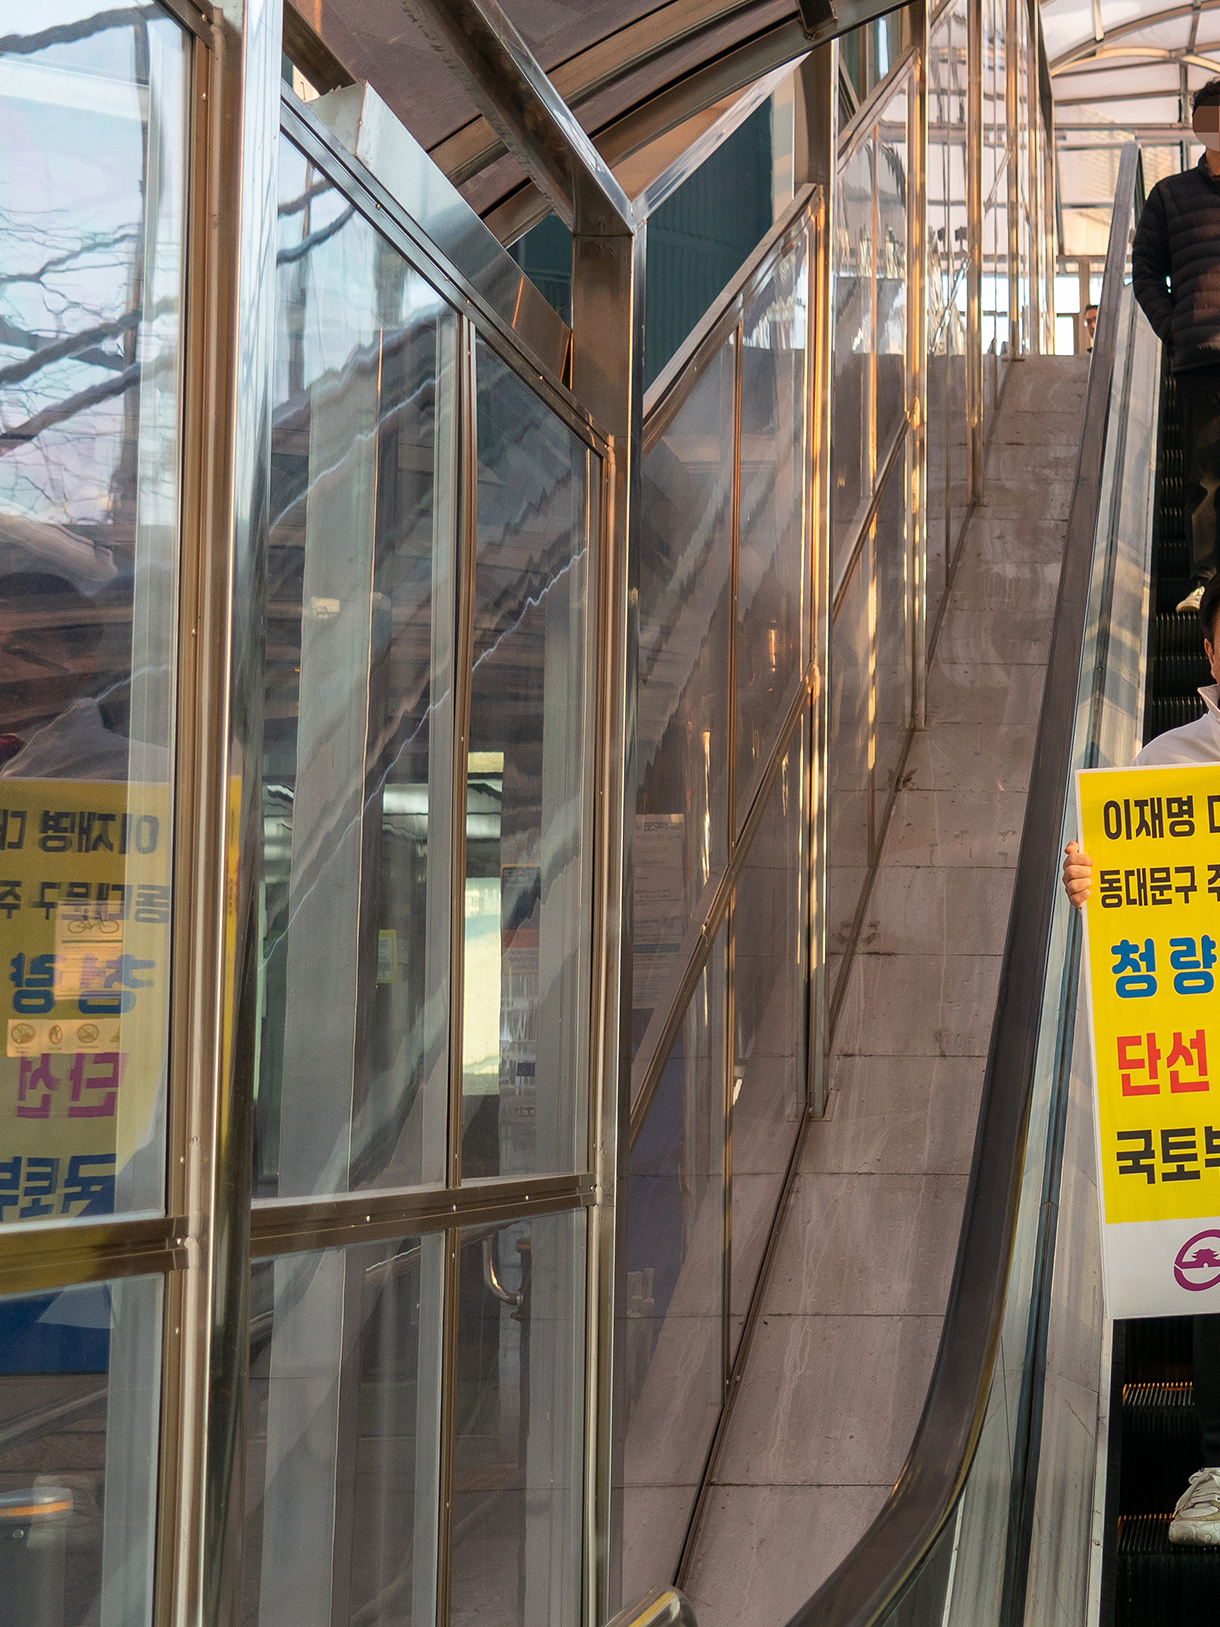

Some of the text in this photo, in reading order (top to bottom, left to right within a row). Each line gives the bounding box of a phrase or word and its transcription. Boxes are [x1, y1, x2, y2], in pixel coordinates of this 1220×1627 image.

[1104, 796, 1194, 839] 이재명
[1100, 866, 1197, 908] 동대문구
[1117, 1030, 1209, 1096] 단선
